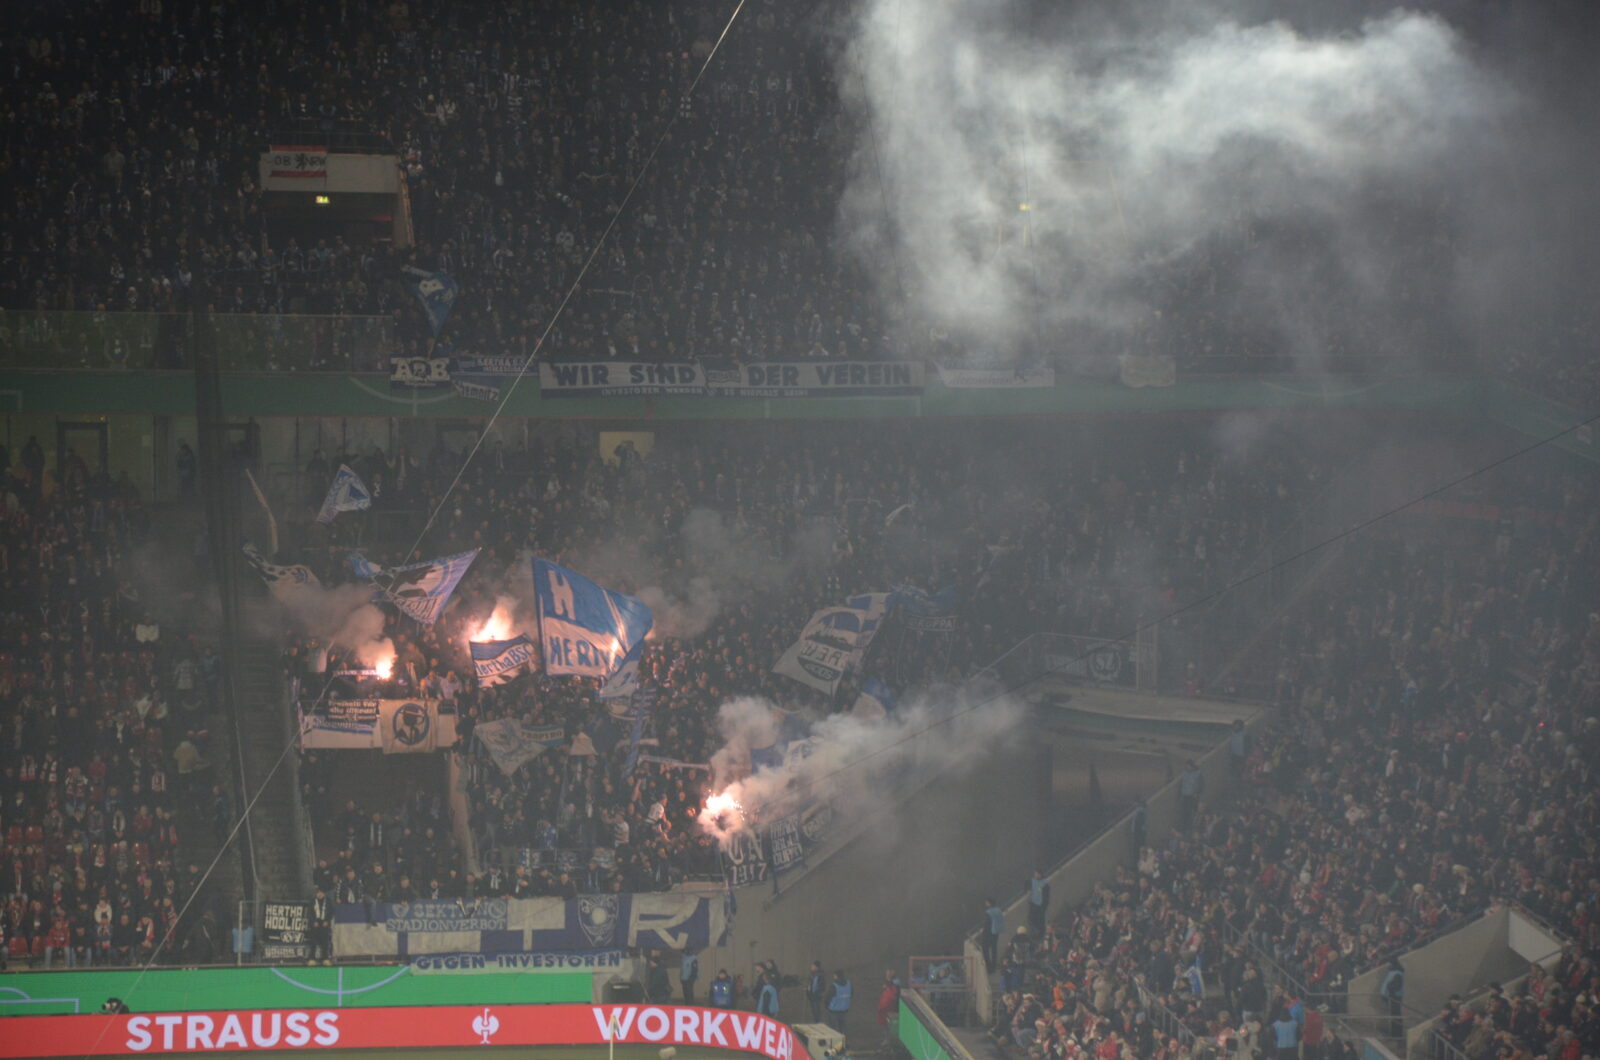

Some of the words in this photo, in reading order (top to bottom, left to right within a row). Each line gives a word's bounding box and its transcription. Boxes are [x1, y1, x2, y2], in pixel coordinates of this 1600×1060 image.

[555, 364, 609, 386] WIR
[629, 363, 696, 384] SIND
[748, 364, 799, 386] DER
[816, 362, 911, 385] VEREIN
[265, 904, 303, 918] HERTHA
[413, 901, 488, 918] SEKTN
[386, 918, 506, 932] STADIONVERBOT
[416, 955, 486, 969] GEGEN
[497, 951, 621, 969] INVESTOREN
[126, 1012, 340, 1051] STRAUSS
